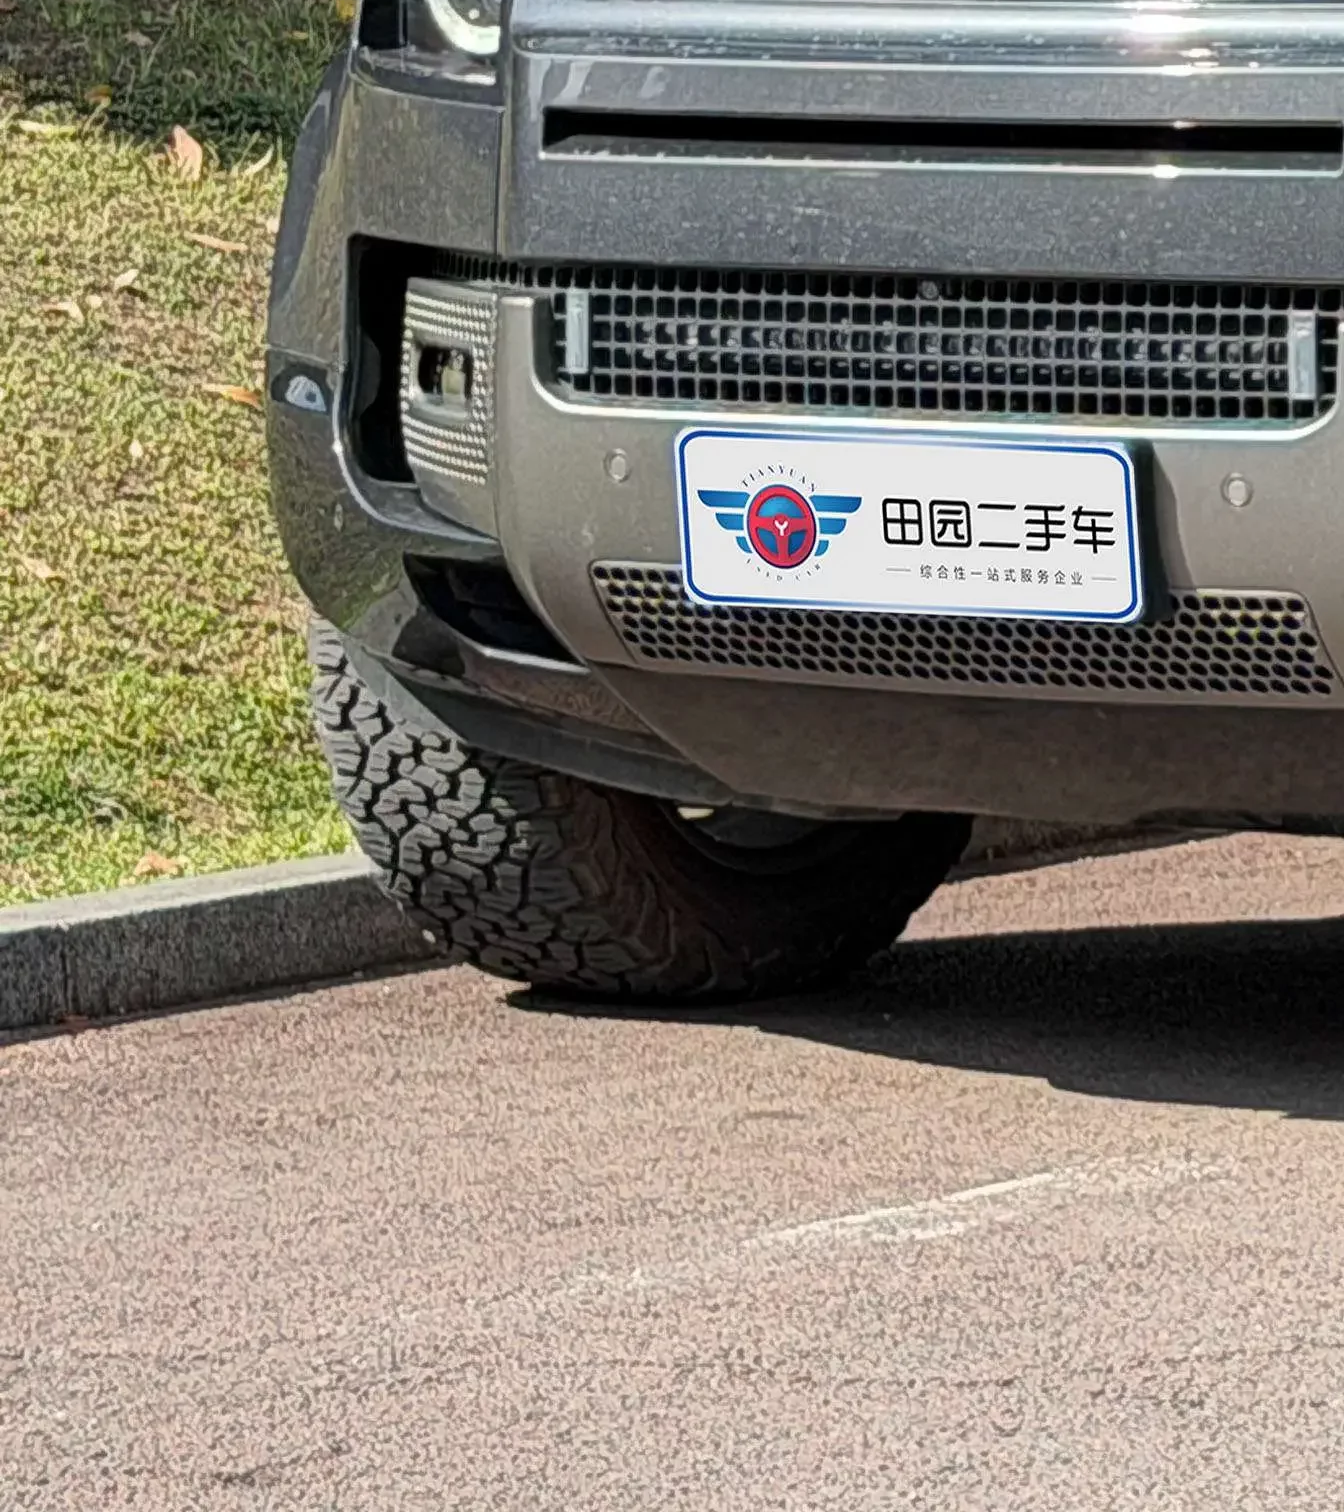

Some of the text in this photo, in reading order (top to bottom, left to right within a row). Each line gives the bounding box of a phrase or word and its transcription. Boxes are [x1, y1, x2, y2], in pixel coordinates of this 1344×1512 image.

[881, 497, 1116, 554] 田园二手车
[919, 563, 1084, 586] 综合性一站式服务企业
